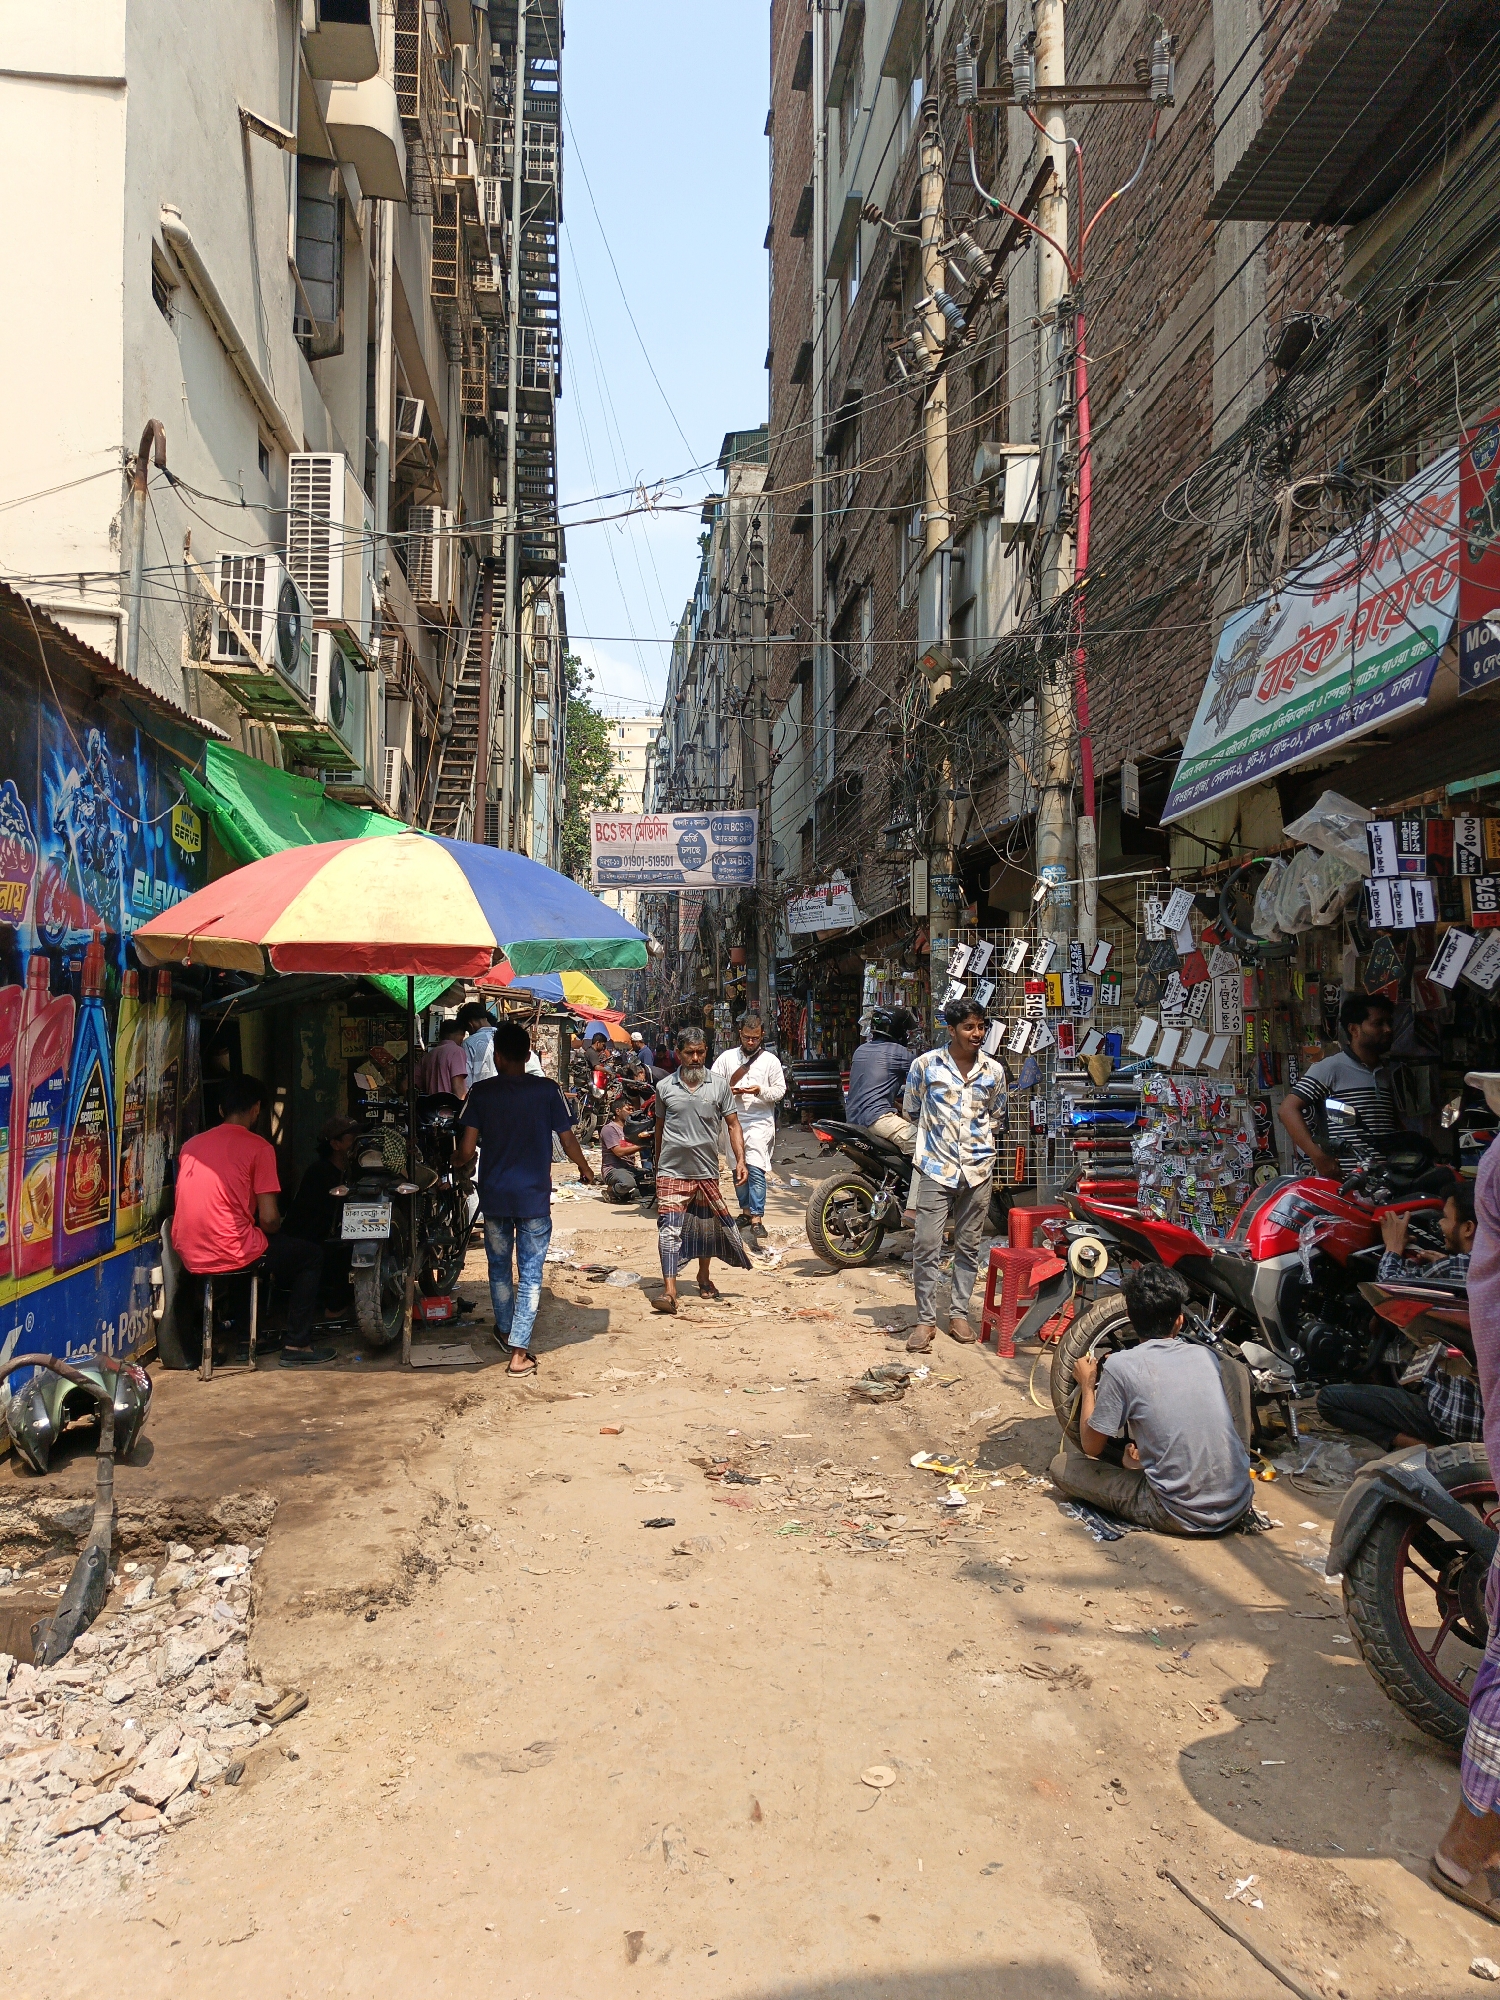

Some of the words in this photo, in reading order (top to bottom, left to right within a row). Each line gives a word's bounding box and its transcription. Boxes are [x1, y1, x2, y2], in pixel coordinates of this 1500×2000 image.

[1256, 612, 1347, 703] বাইক
[180, 809, 194, 826] MAK
[595, 823, 617, 841] BCS
[635, 816, 668, 842] মেডিসিন
[730, 822, 745, 832] BCS
[174, 824, 200, 847] SERVE
[623, 856, 674, 867] 01901-519501
[1376, 857, 1385, 873] ঢাকা
[132, 868, 194, 911] ELEVA
[1370, 889, 1379, 908] মেট্রো
[1475, 877, 1497, 910] 6976
[1070, 945, 1079, 973] 2672
[1481, 957, 1500, 985] ১১-২
[1026, 995, 1043, 1016] 5149
[1102, 985, 1110, 1004] 7421
[1219, 978, 1230, 1010] মেট্রো-গ
[1221, 1012, 1230, 1030] ঢাকা
[1246, 1022, 1254, 1054] SUZUKI
[1288, 1055, 1297, 1085] ENEOS
[29, 1101, 49, 1117] MAK
[1274, 1216, 1298, 1231] YAMAH
[101, 1321, 115, 1358] it
